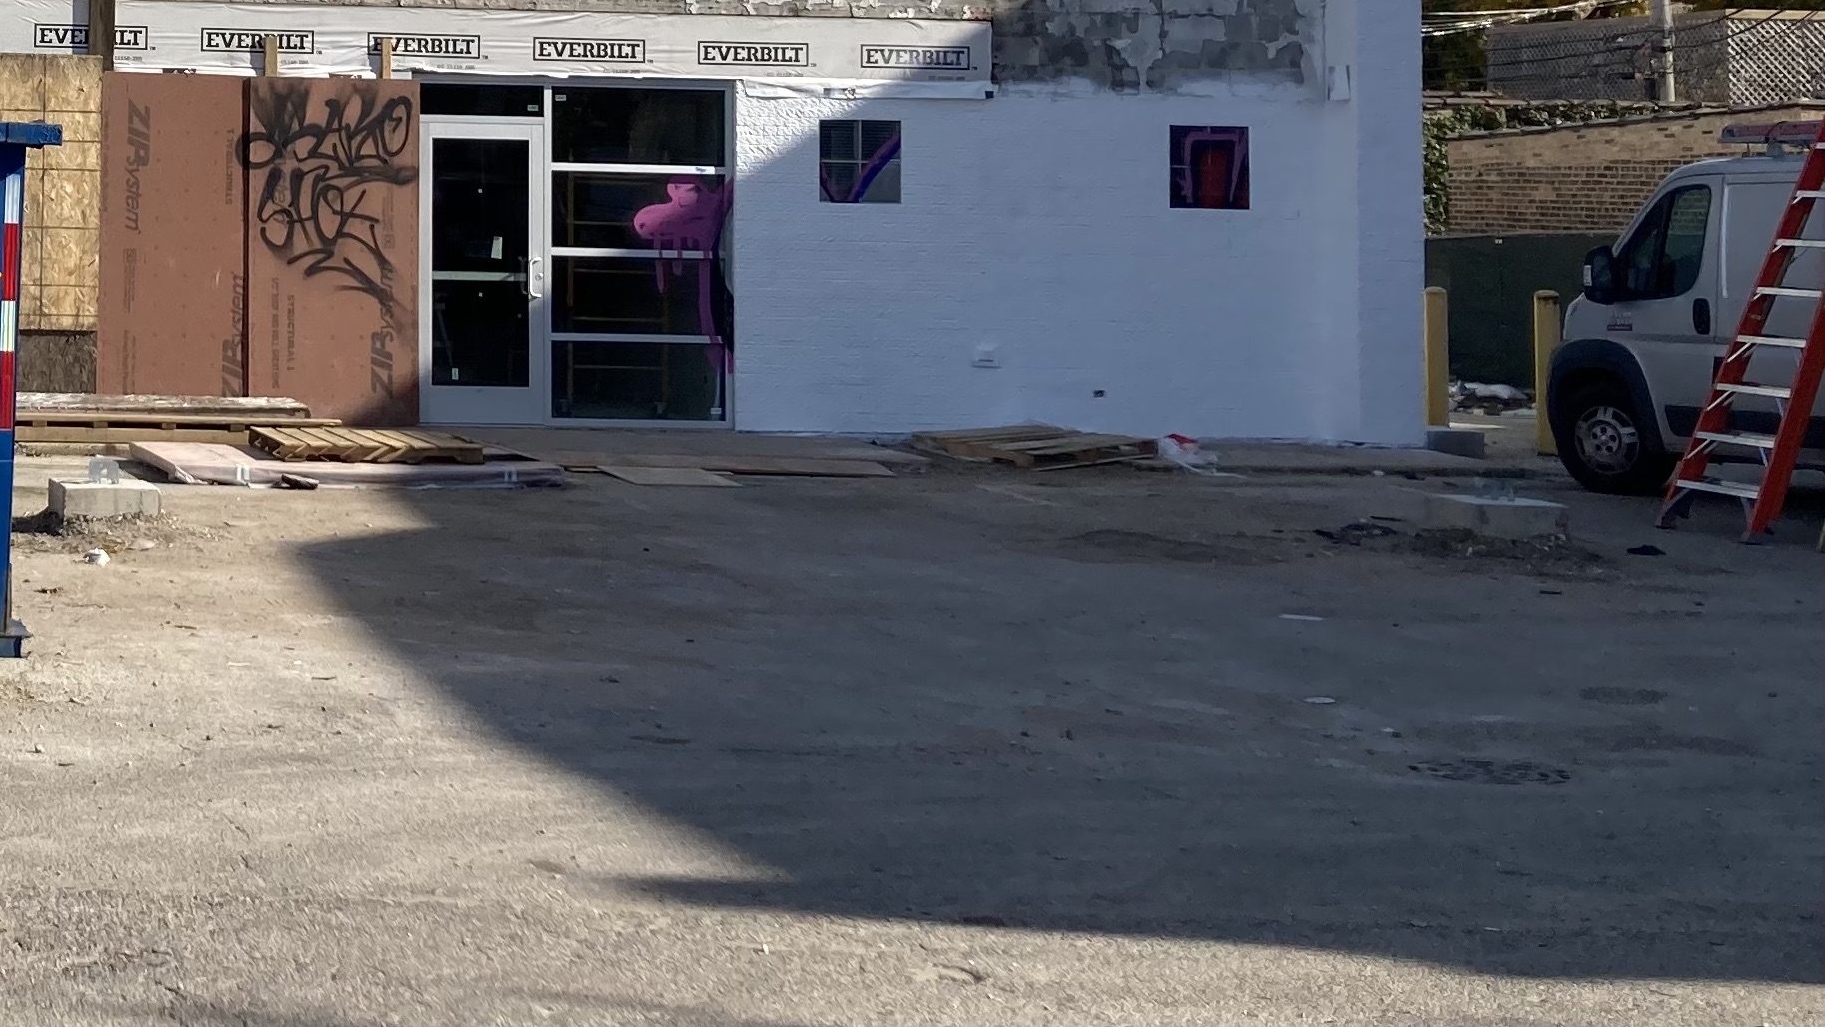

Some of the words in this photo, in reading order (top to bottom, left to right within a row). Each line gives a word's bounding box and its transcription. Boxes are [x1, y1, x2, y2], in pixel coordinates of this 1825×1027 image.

[39, 28, 142, 45] EVEILT
[206, 32, 309, 50] EVERILT
[538, 41, 641, 58] EVERBILT
[702, 45, 804, 62] EVERBILT
[865, 48, 965, 66] EVERBILT
